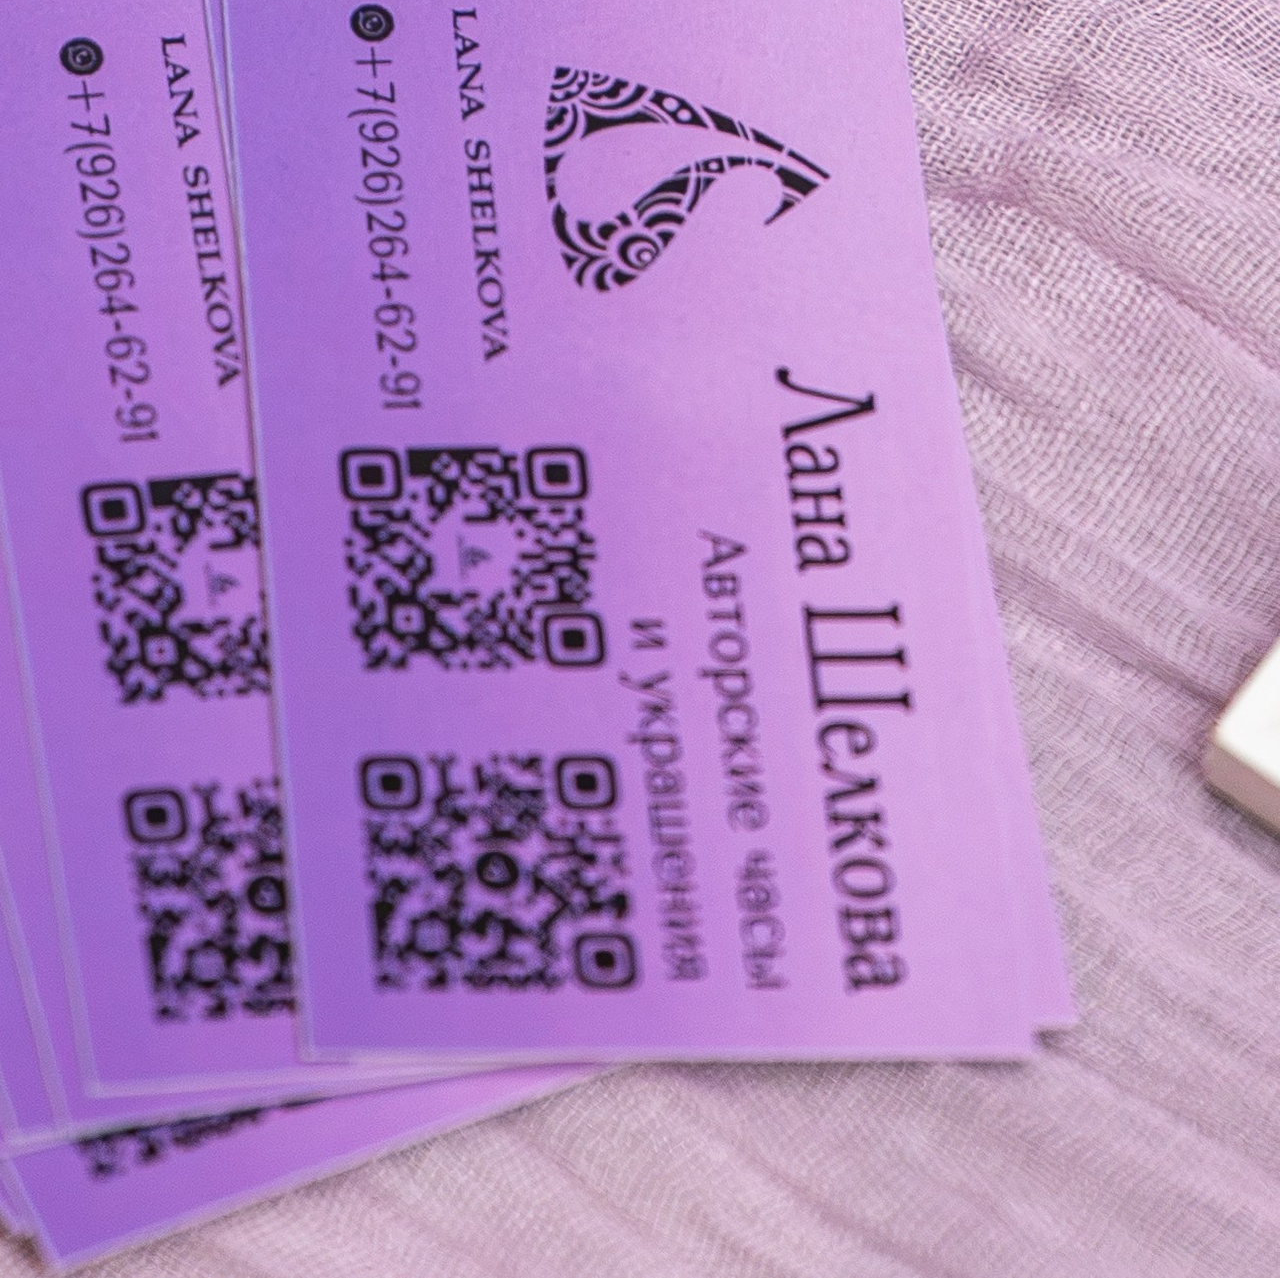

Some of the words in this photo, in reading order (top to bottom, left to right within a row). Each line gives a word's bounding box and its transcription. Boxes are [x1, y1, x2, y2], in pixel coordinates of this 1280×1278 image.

[161, 33, 201, 148] LANA
[183, 165, 242, 388] SHELKOVA
[451, 8, 486, 122] LANA
[348, 47, 422, 411] +7(926)264-62-91
[464, 138, 510, 362] SHELKOVA
[775, 366, 875, 574] Лана
[630, 617, 667, 650] и
[697, 529, 770, 833] Авторские
[736, 849, 790, 990] часы
[618, 671, 709, 982] украшения
[803, 601, 916, 996] Шелкова
